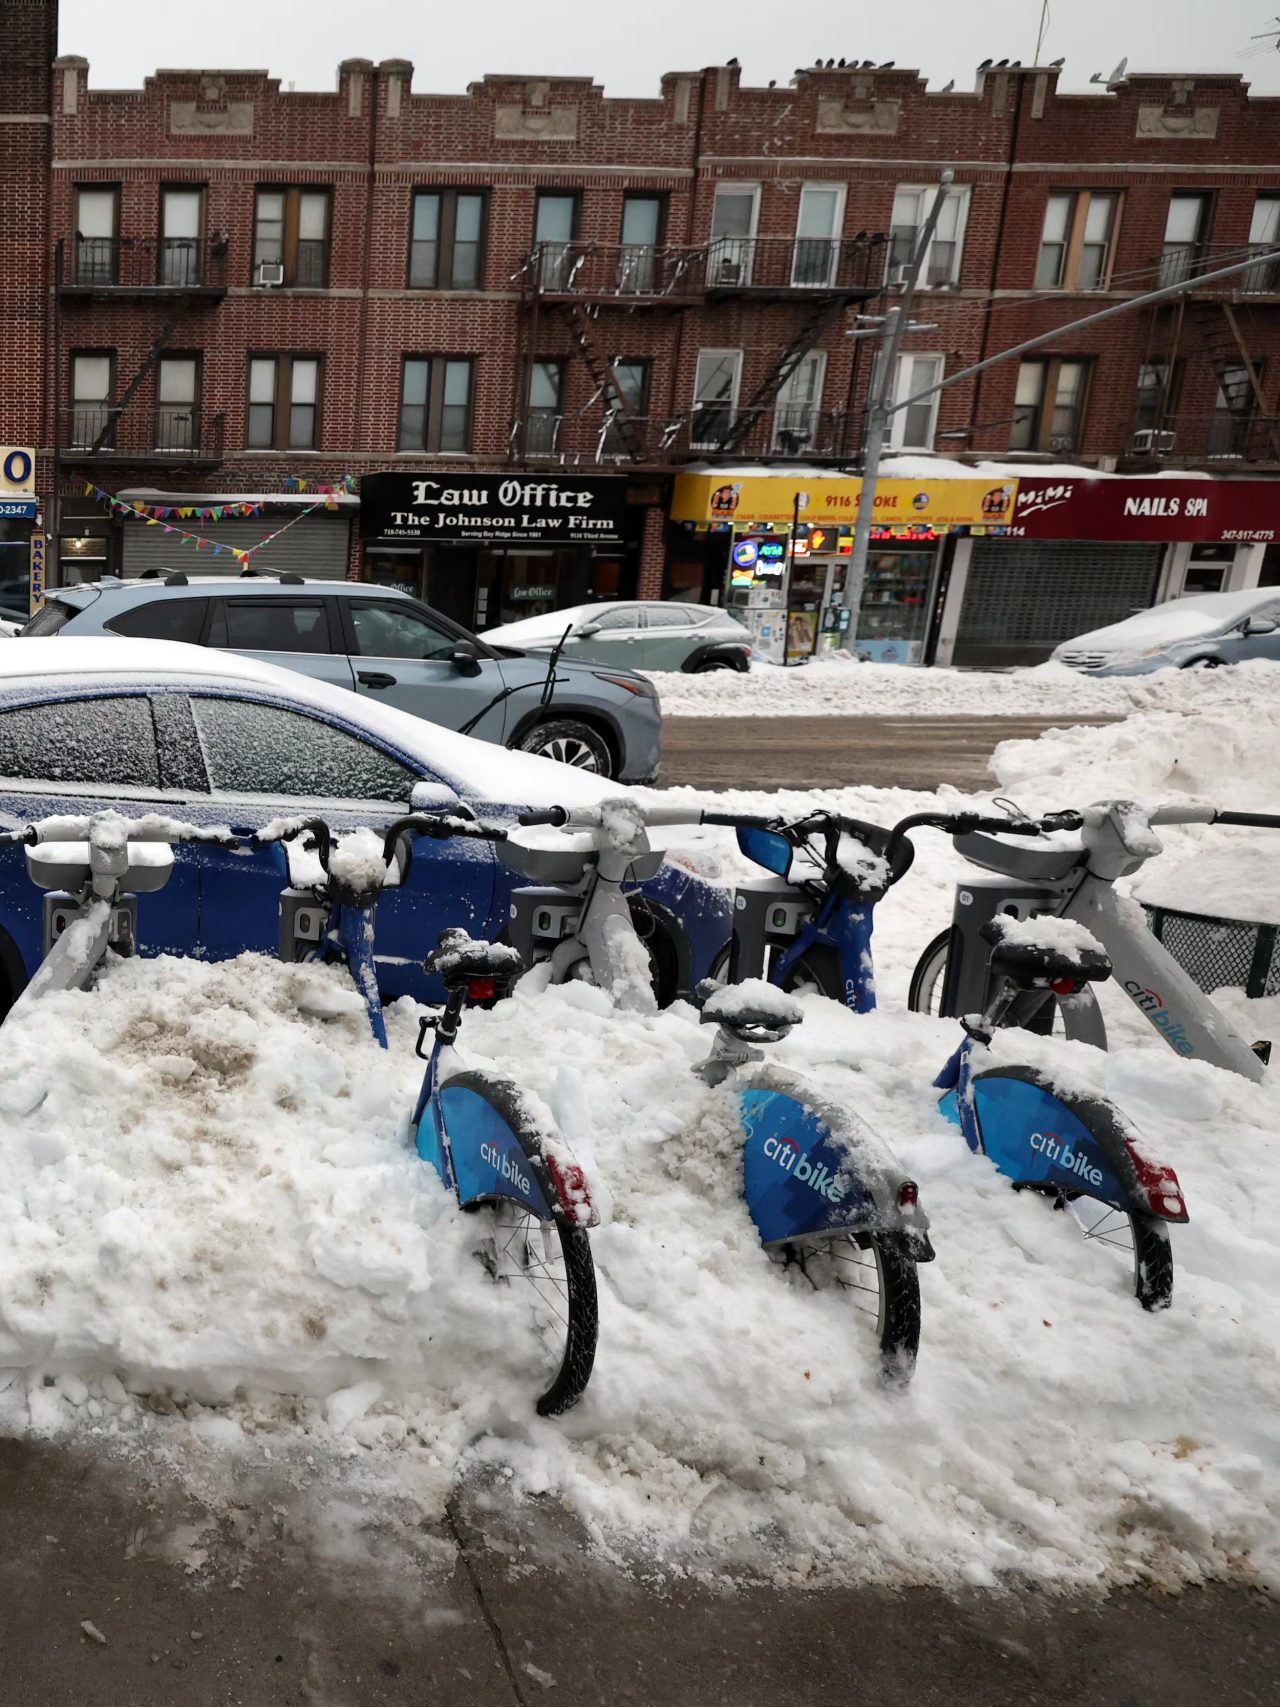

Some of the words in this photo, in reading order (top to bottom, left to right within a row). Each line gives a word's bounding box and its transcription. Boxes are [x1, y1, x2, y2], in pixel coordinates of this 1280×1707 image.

[411, 481, 489, 506] Law
[498, 480, 595, 508] Office
[825, 495, 851, 507] 9116
[1123, 498, 1180, 516] NAILS
[1184, 498, 1208, 517] SPA
[391, 512, 431, 525] The
[434, 513, 516, 528] Johnson
[521, 514, 563, 528] Law
[567, 515, 614, 529] Firm
[461, 530, 482, 538] Serving
[32, 540, 44, 603] BAKERY
[480, 1142, 501, 1171] citi
[501, 1154, 531, 1195] bike
[763, 1137, 800, 1171] citi
[793, 1153, 846, 1203] bike
[1030, 1132, 1062, 1161] citi
[1060, 1145, 1103, 1186] bike
